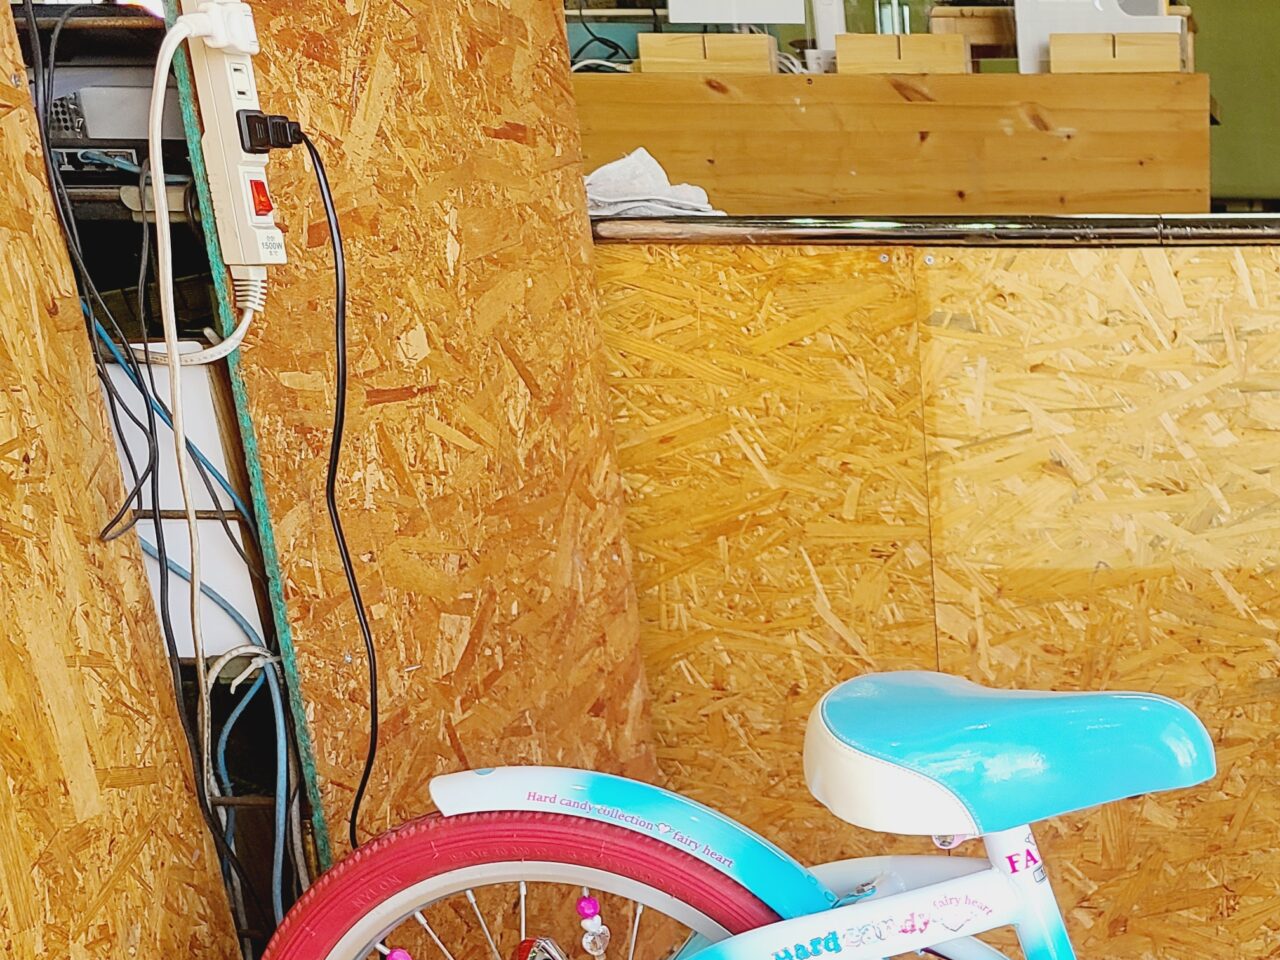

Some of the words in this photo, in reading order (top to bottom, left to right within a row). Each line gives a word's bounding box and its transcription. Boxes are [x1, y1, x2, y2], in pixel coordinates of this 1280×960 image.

[261, 242, 283, 250] 1500W
[526, 791, 557, 804] Hard
[559, 798, 595, 814] candy
[597, 806, 655, 831] collection
[672, 831, 701, 851] fairy
[702, 845, 734, 869] heart
[933, 896, 960, 910] fairy
[964, 895, 993, 916] heart
